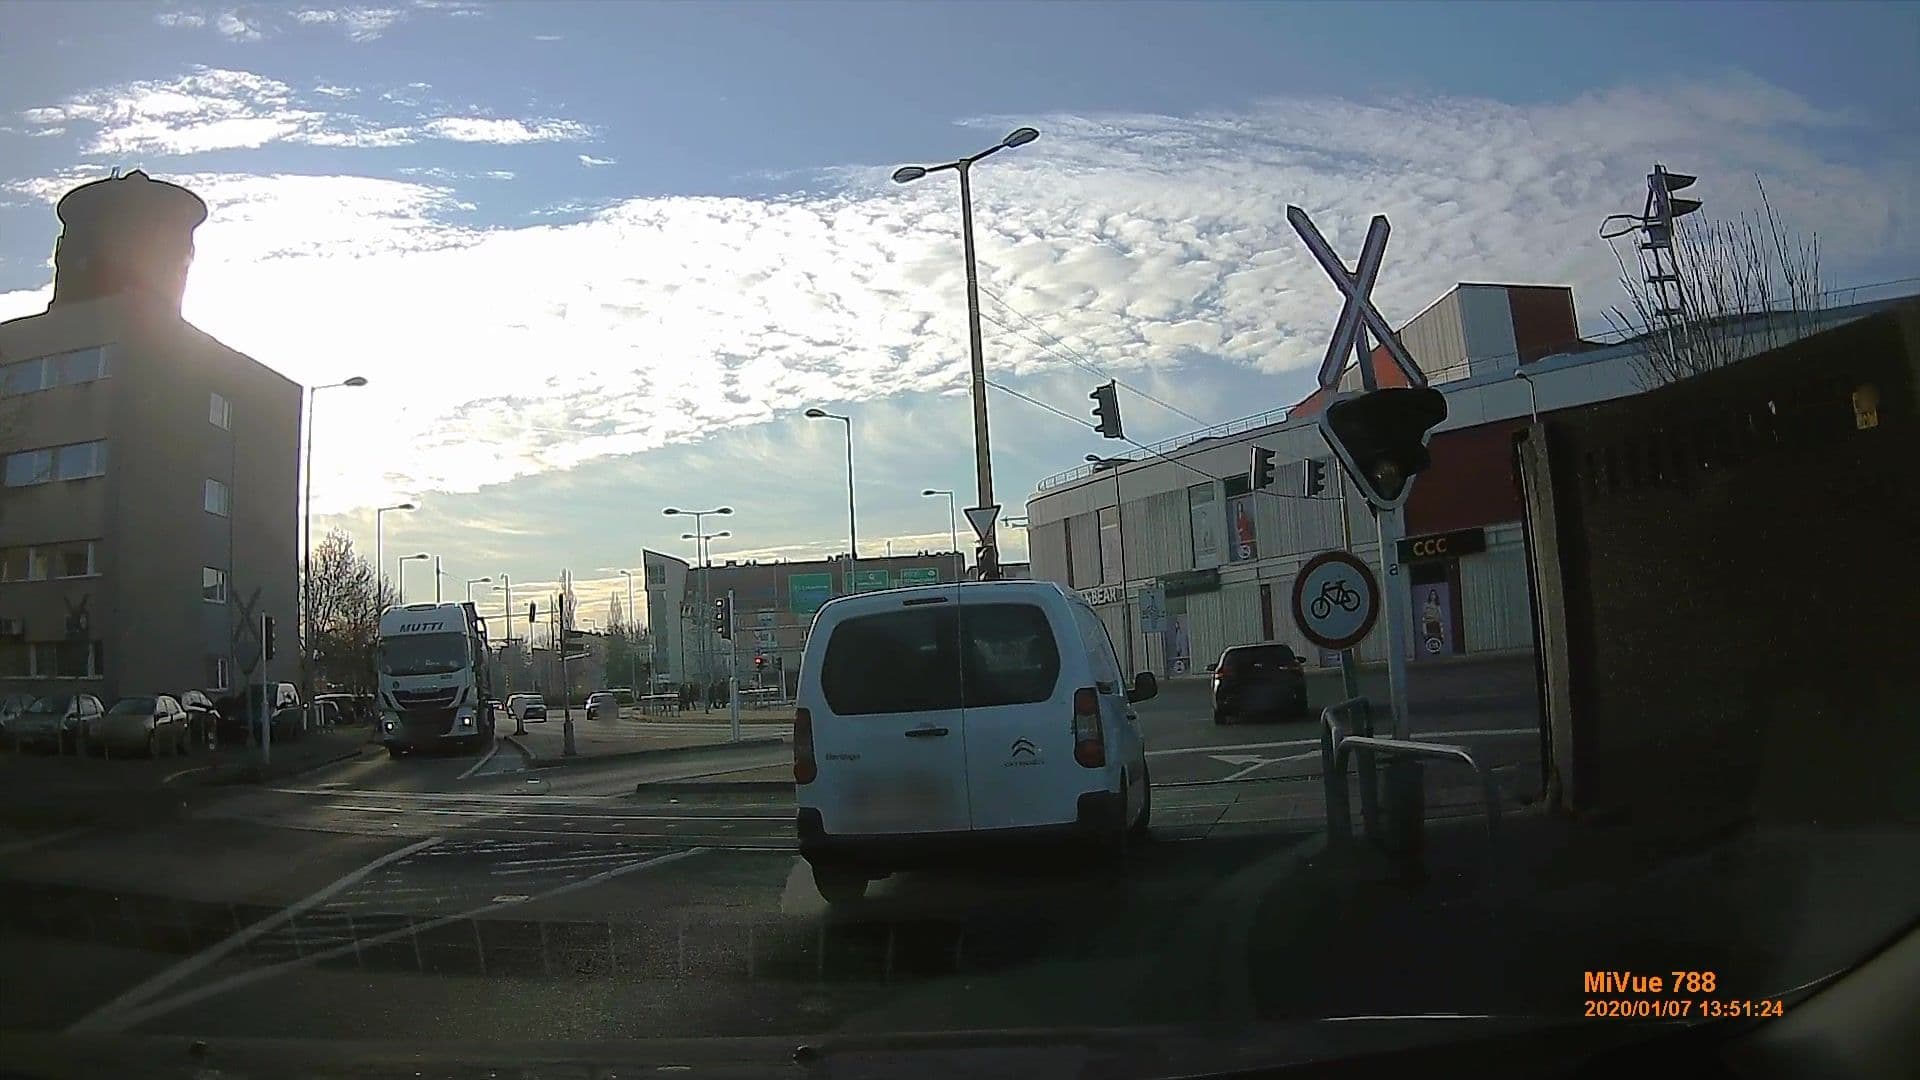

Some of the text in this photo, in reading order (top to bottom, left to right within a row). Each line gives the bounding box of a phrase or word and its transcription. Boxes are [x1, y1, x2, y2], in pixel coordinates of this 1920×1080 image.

[1413, 539, 1447, 556] CCC
[1389, 563, 1399, 576] a
[400, 622, 444, 633] MUTTI
